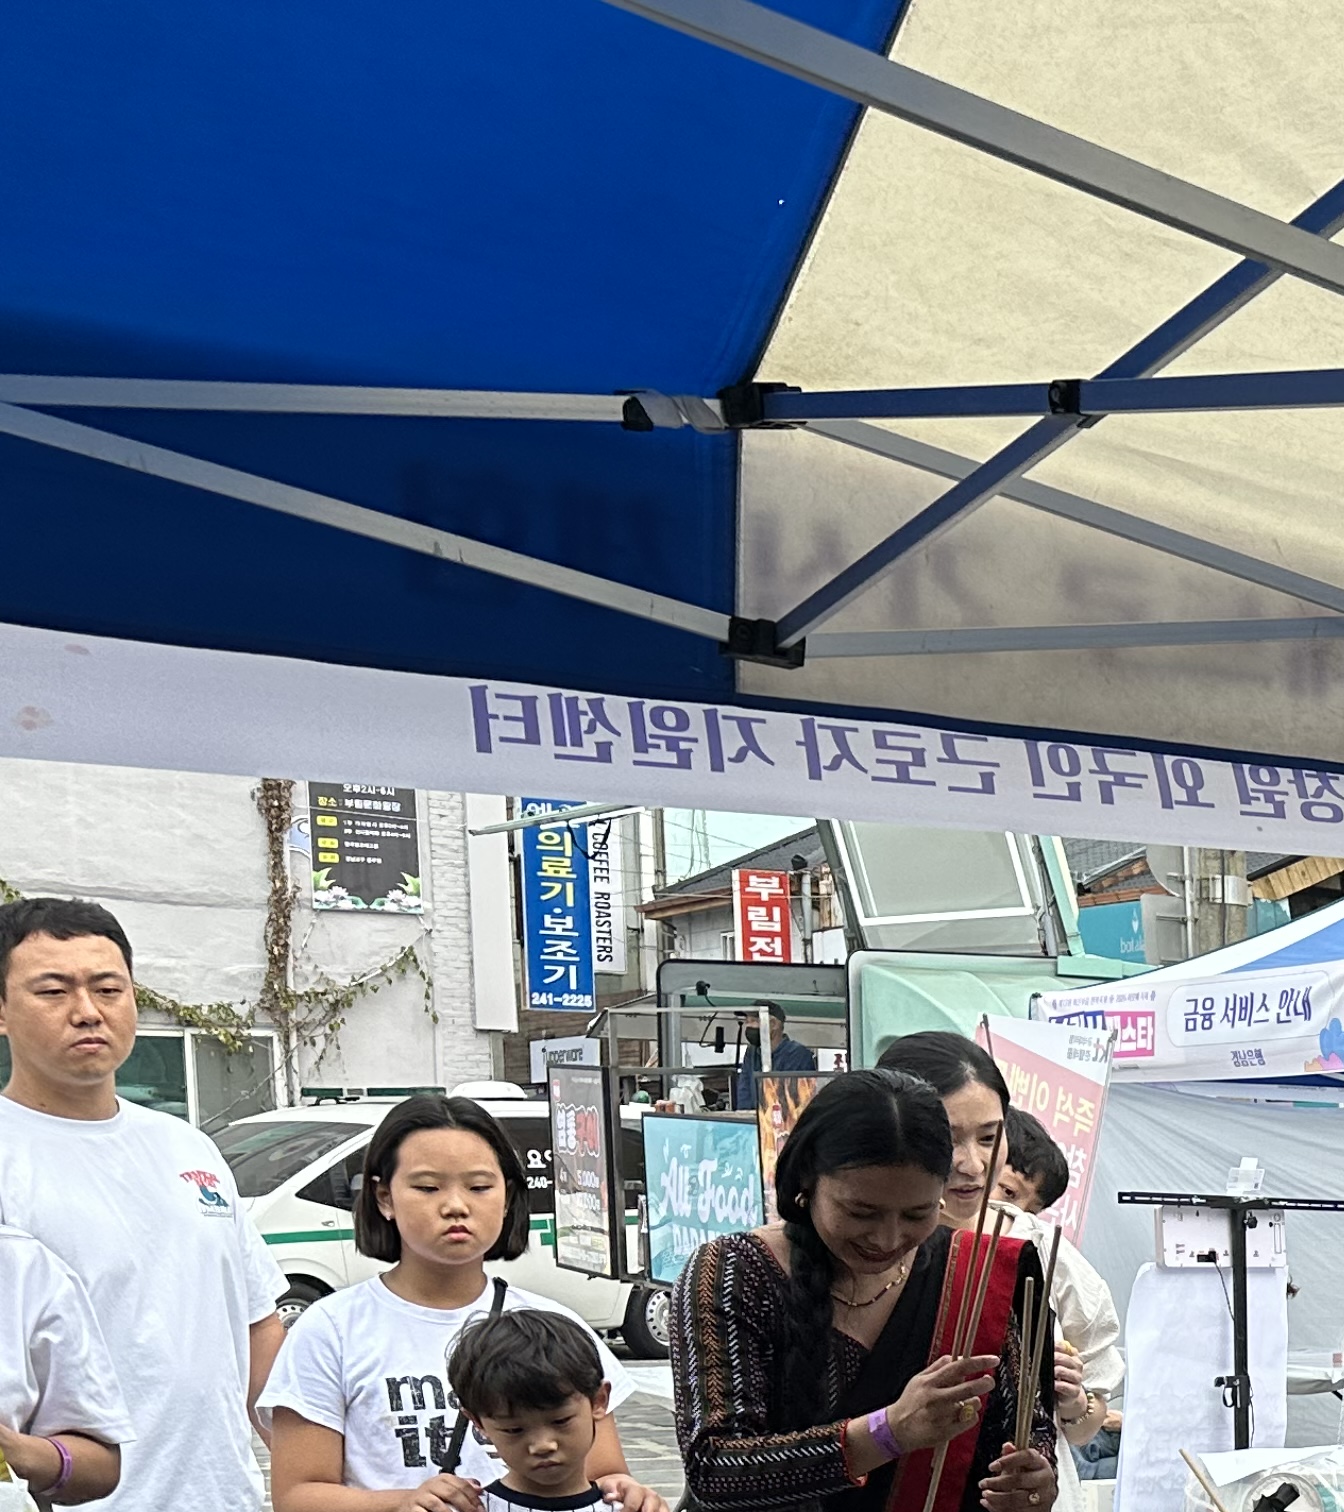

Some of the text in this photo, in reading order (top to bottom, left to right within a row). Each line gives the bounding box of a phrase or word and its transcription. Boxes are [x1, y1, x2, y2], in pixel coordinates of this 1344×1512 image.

[594, 891, 613, 963] ROASTERS
[1184, 996, 1217, 1032] 금융
[1220, 991, 1271, 1028] 서비스
[1276, 985, 1313, 1025] 안내
[1231, 1048, 1266, 1067] 경남은행
